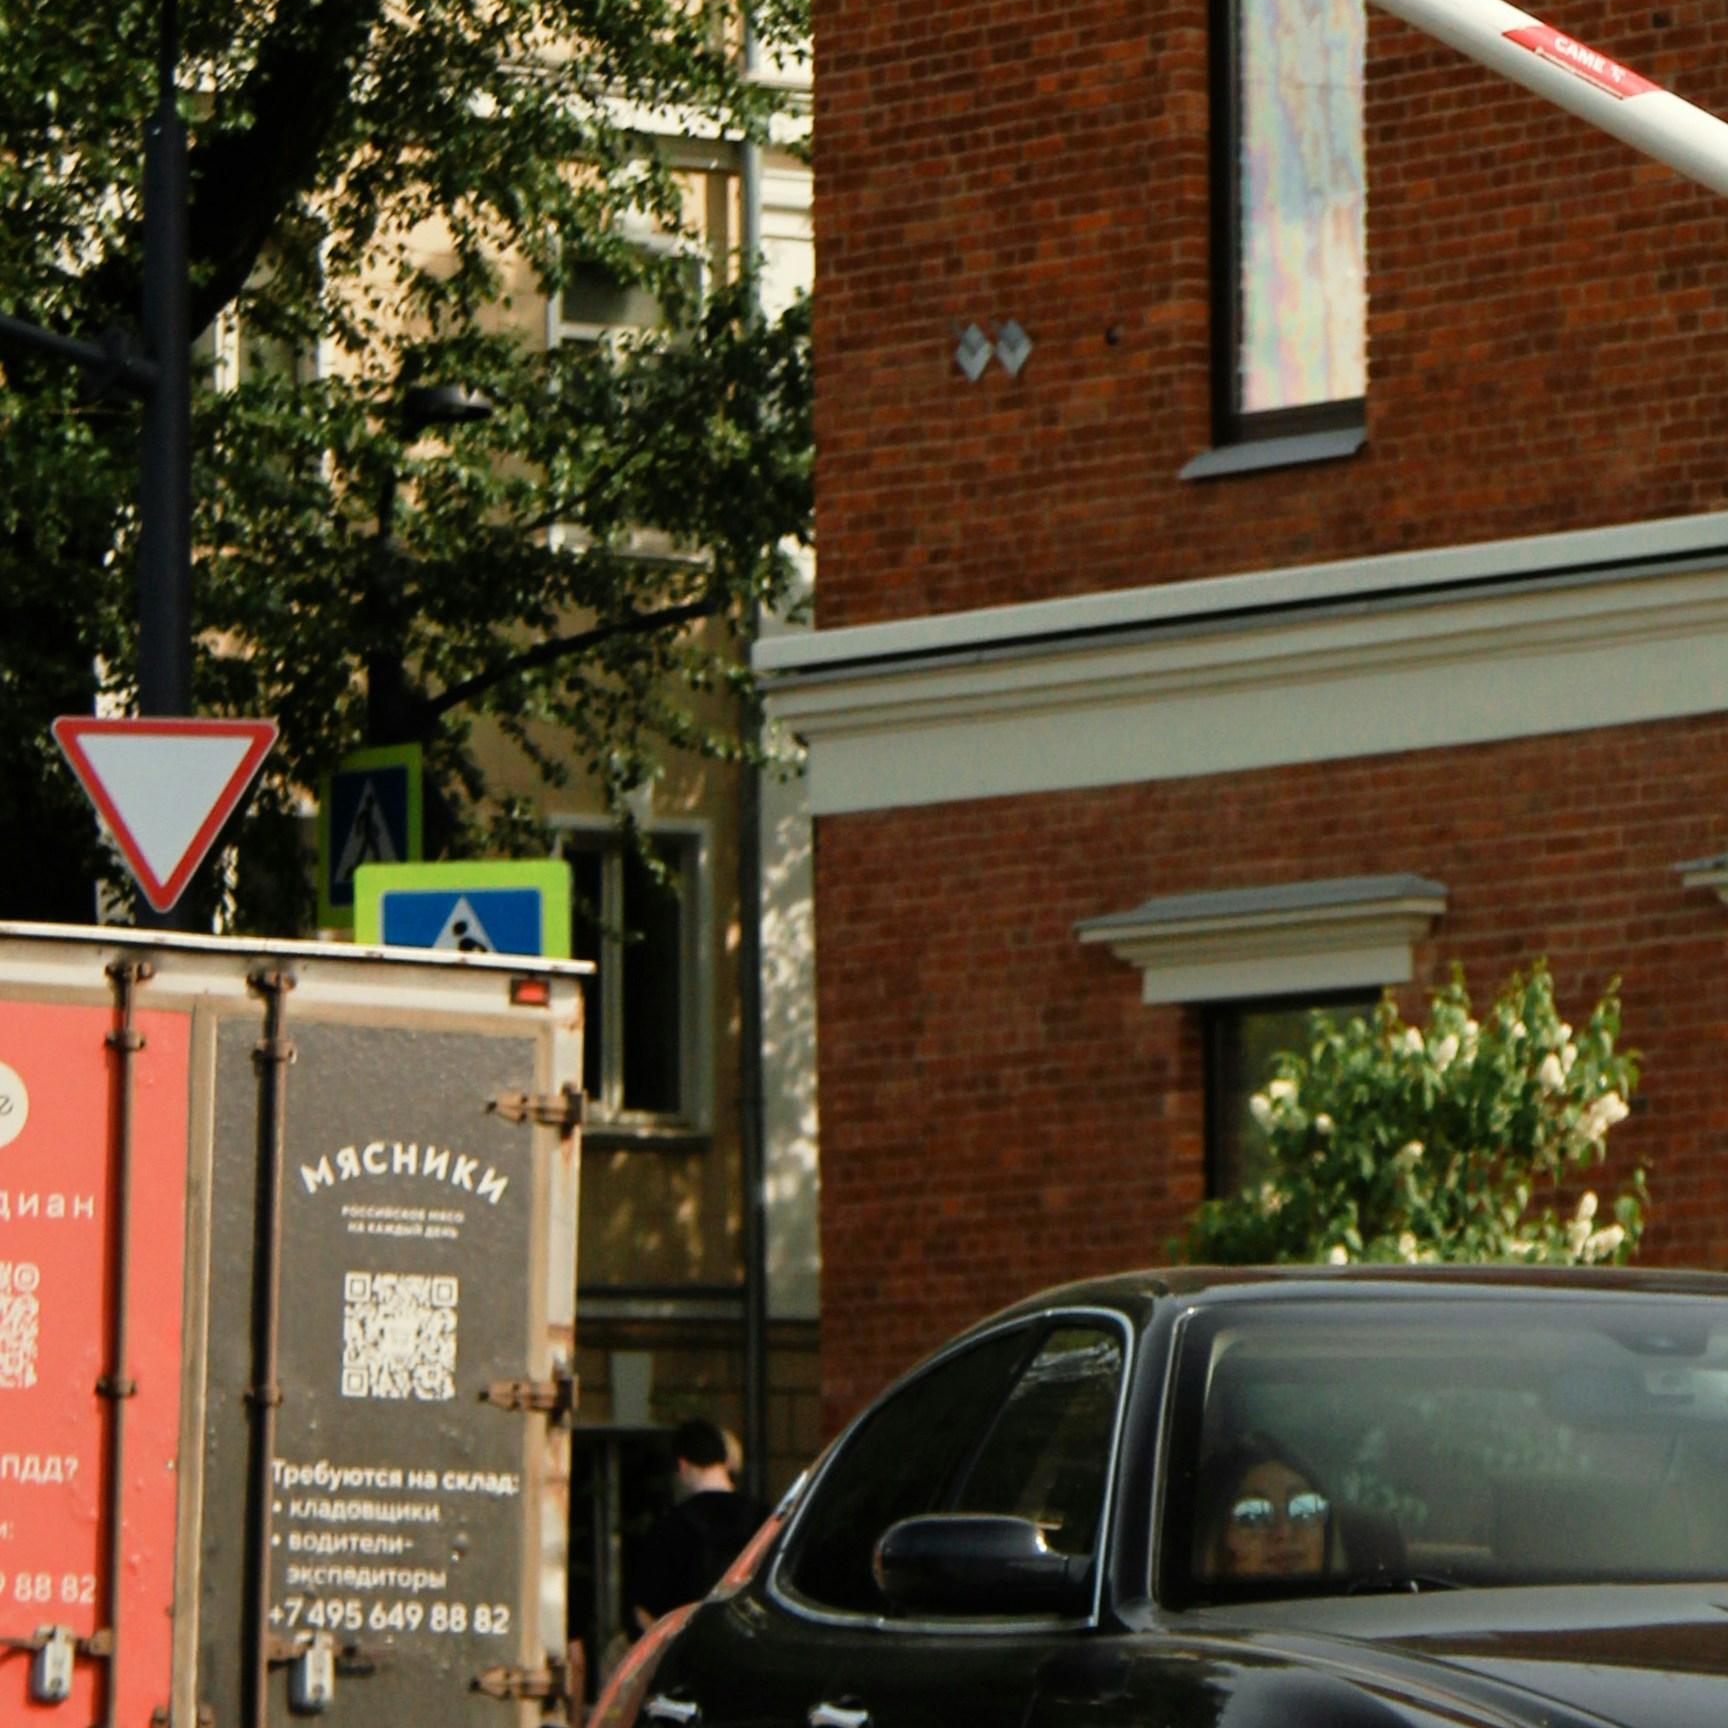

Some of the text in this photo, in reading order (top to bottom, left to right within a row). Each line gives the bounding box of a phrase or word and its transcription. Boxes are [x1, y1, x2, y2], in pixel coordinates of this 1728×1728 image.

[1554, 36, 1606, 74] CAME
[300, 1140, 510, 1206] МЯСНИКИ
[272, 1458, 520, 1495] Требуются на склад:
[290, 1498, 440, 1522] кладовщики
[288, 1531, 414, 1554] водители-
[14, 1573, 52, 1603] 88
[61, 1573, 96, 1604] 82
[286, 1565, 447, 1592] экспедиторы
[269, 1597, 510, 1635] +7 495 649 88 82
